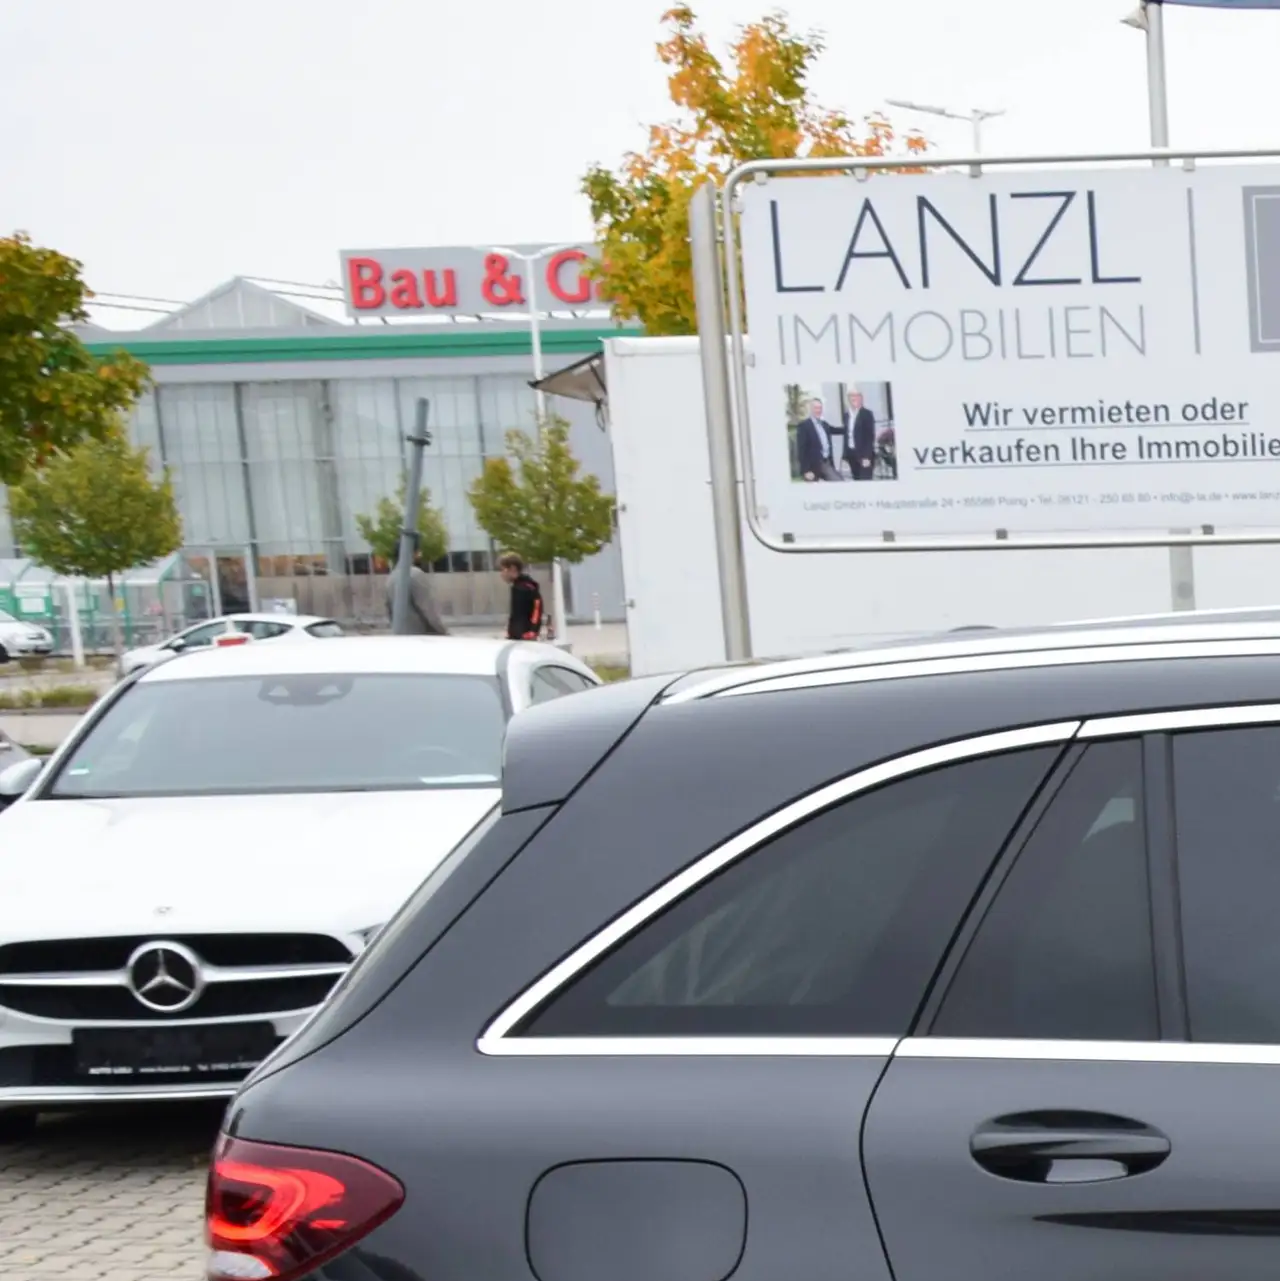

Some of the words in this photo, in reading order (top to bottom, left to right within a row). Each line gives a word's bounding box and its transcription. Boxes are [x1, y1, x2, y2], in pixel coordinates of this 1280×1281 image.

[769, 188, 1142, 294] LANZL
[347, 257, 458, 310] Bau
[481, 252, 525, 306] &
[776, 304, 1148, 366] IMMOBILIEN
[963, 402, 1015, 427] Wir
[1022, 400, 1169, 426] vermieten
[1182, 397, 1248, 421] oder
[913, 438, 1062, 466] verkaufen
[1072, 437, 1127, 462] Ihre
